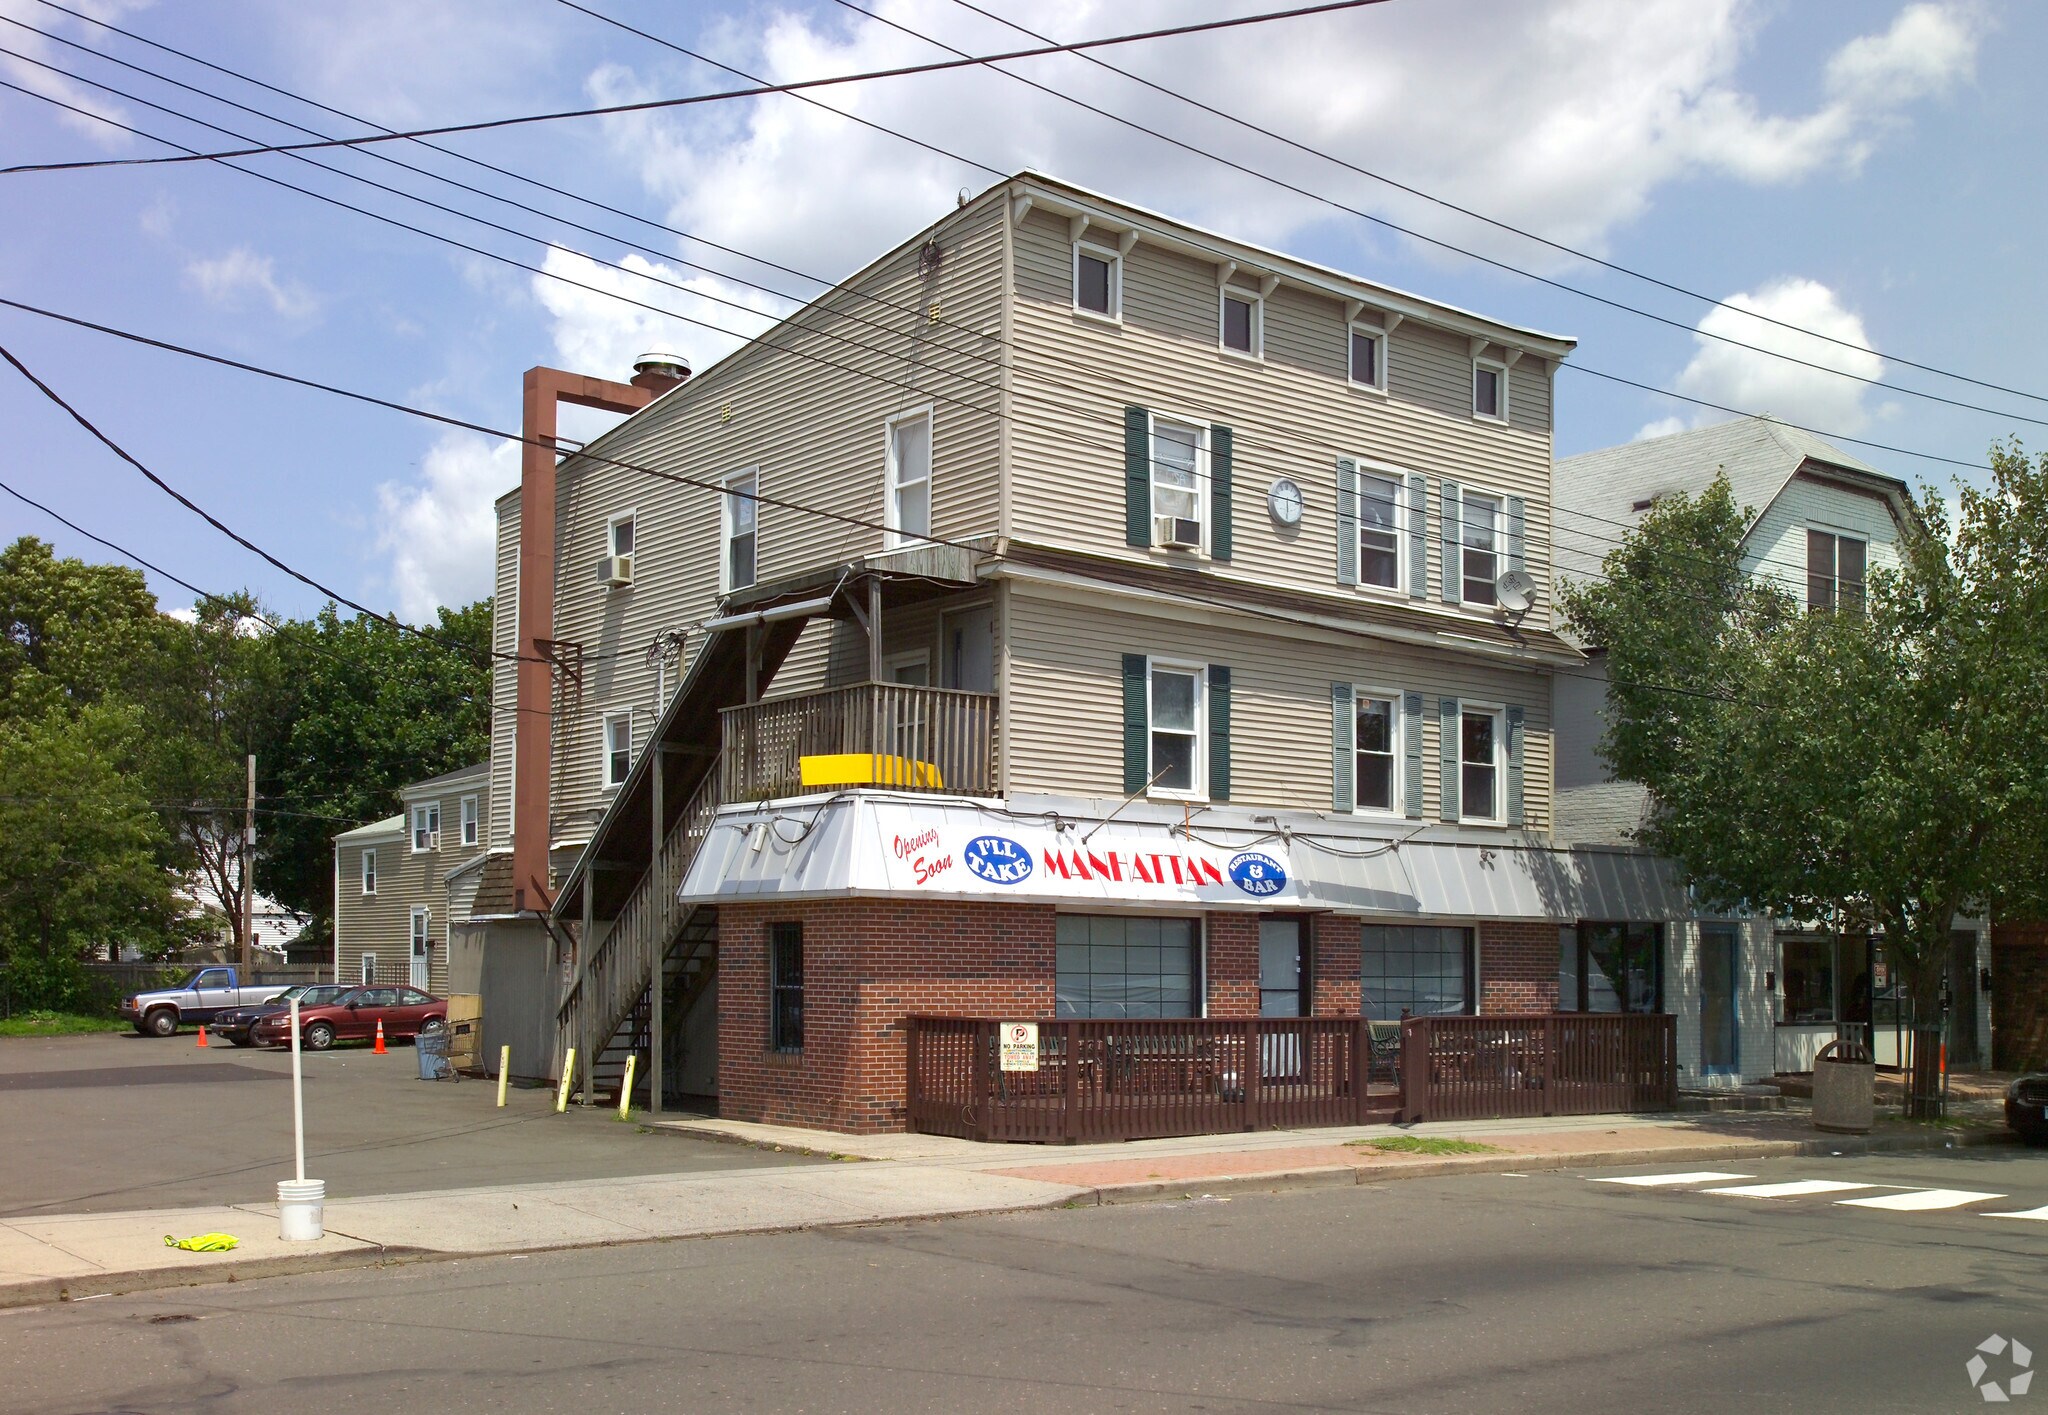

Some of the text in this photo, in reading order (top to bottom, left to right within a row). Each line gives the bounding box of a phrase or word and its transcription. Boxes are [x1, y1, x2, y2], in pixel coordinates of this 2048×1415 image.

[894, 828, 939, 861] Opening
[976, 839, 1017, 859] I'LL
[913, 854, 953, 885] Soon
[968, 851, 1031, 882] TAKE
[1044, 847, 1224, 887] MANHATTAN
[1229, 853, 1283, 873] RESTAURANT
[1249, 864, 1263, 879] &
[1243, 877, 1278, 893] BAR
